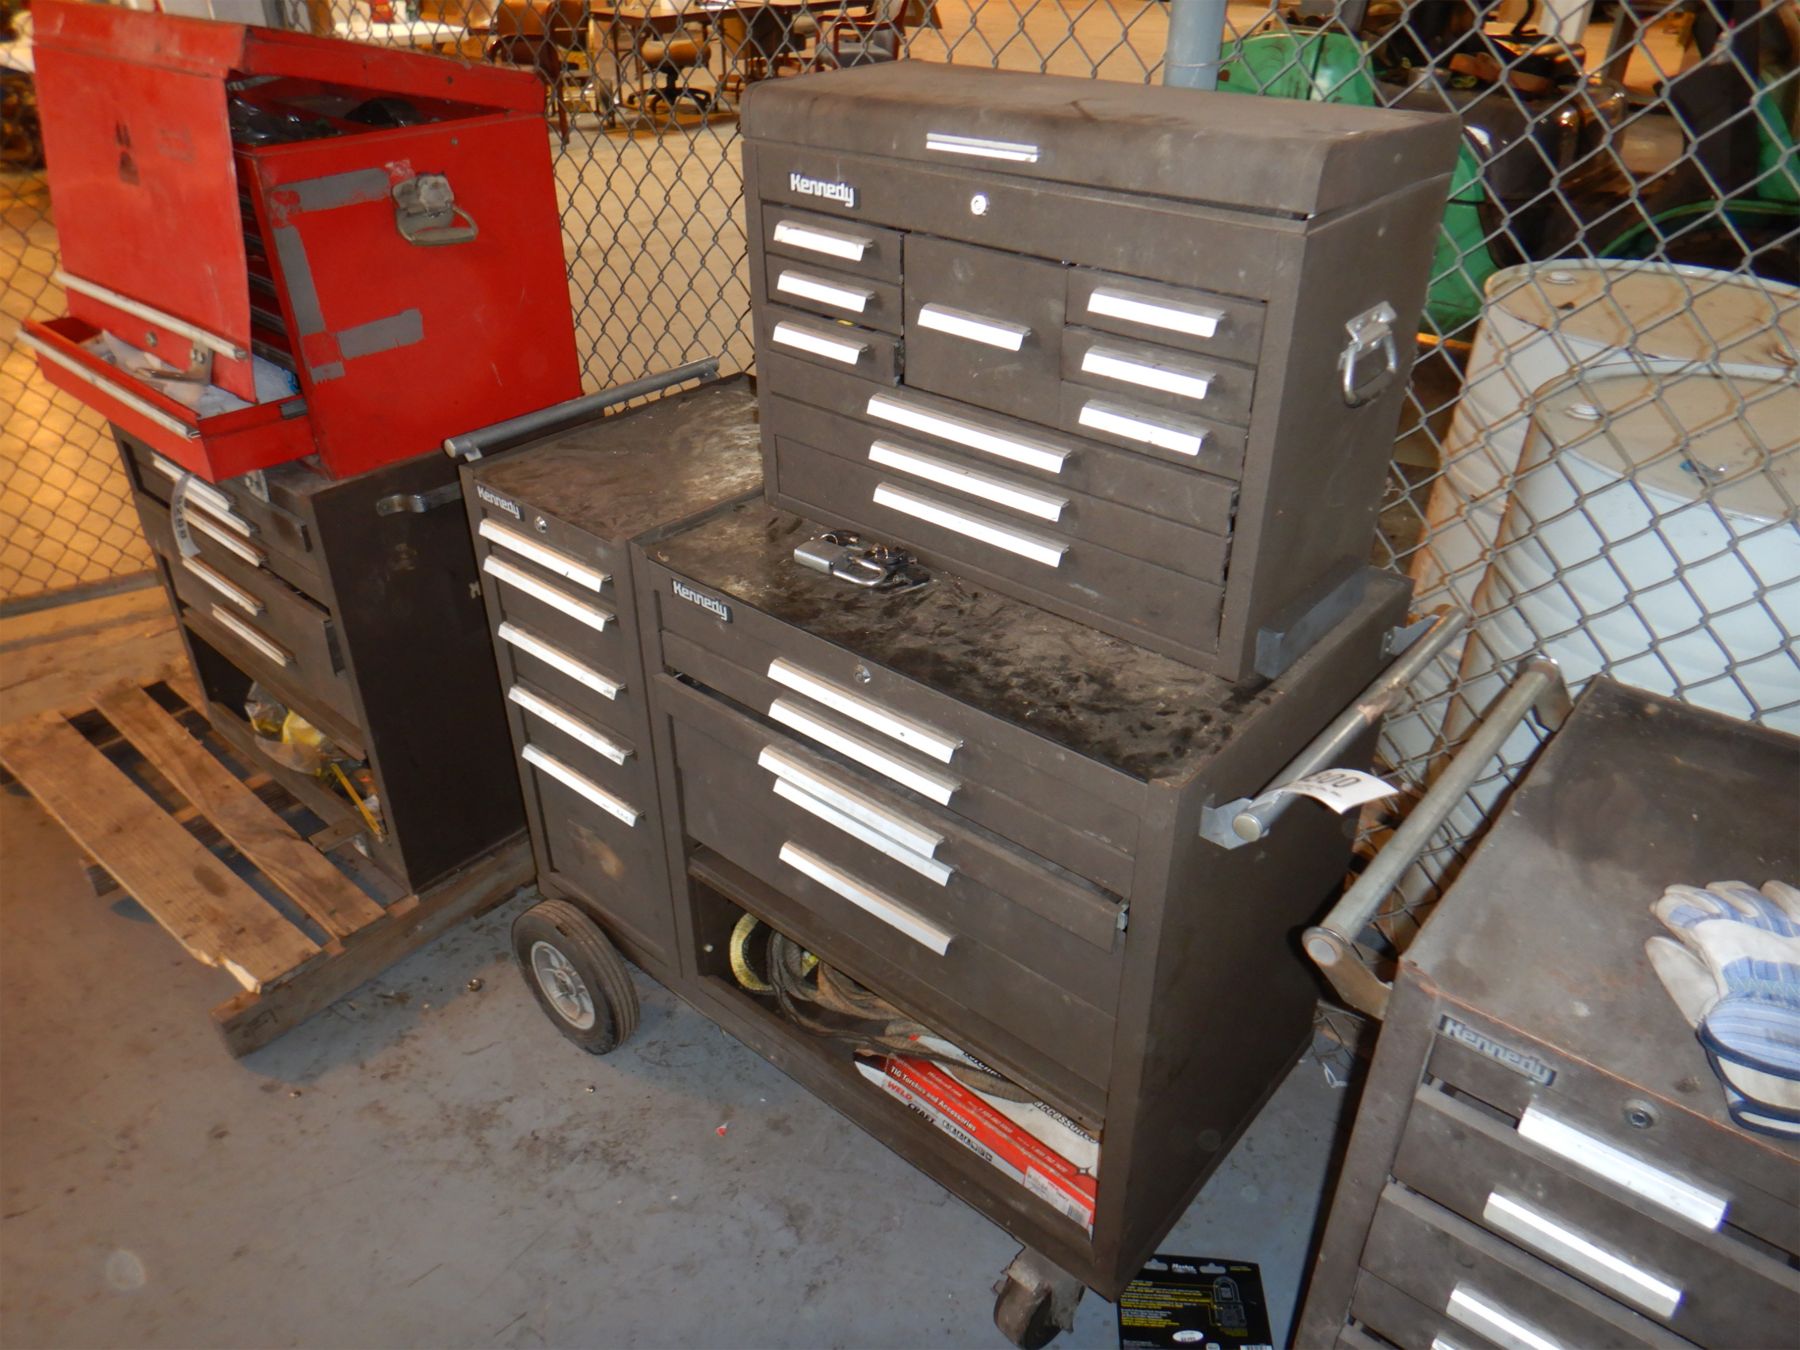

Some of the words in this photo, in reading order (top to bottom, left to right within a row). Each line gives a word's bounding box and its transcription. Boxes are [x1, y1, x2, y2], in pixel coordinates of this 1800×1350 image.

[790, 173, 854, 208] Kennedy
[477, 485, 520, 519] Kennedy
[673, 580, 728, 621] Kennedy
[1443, 1018, 1553, 1085] Kennedy
[887, 1080, 913, 1101] WELD
[890, 1065, 903, 1078] TIG
[902, 1073, 926, 1095] Torches
[926, 1090, 939, 1103] and
[938, 1099, 977, 1132] Accessories
